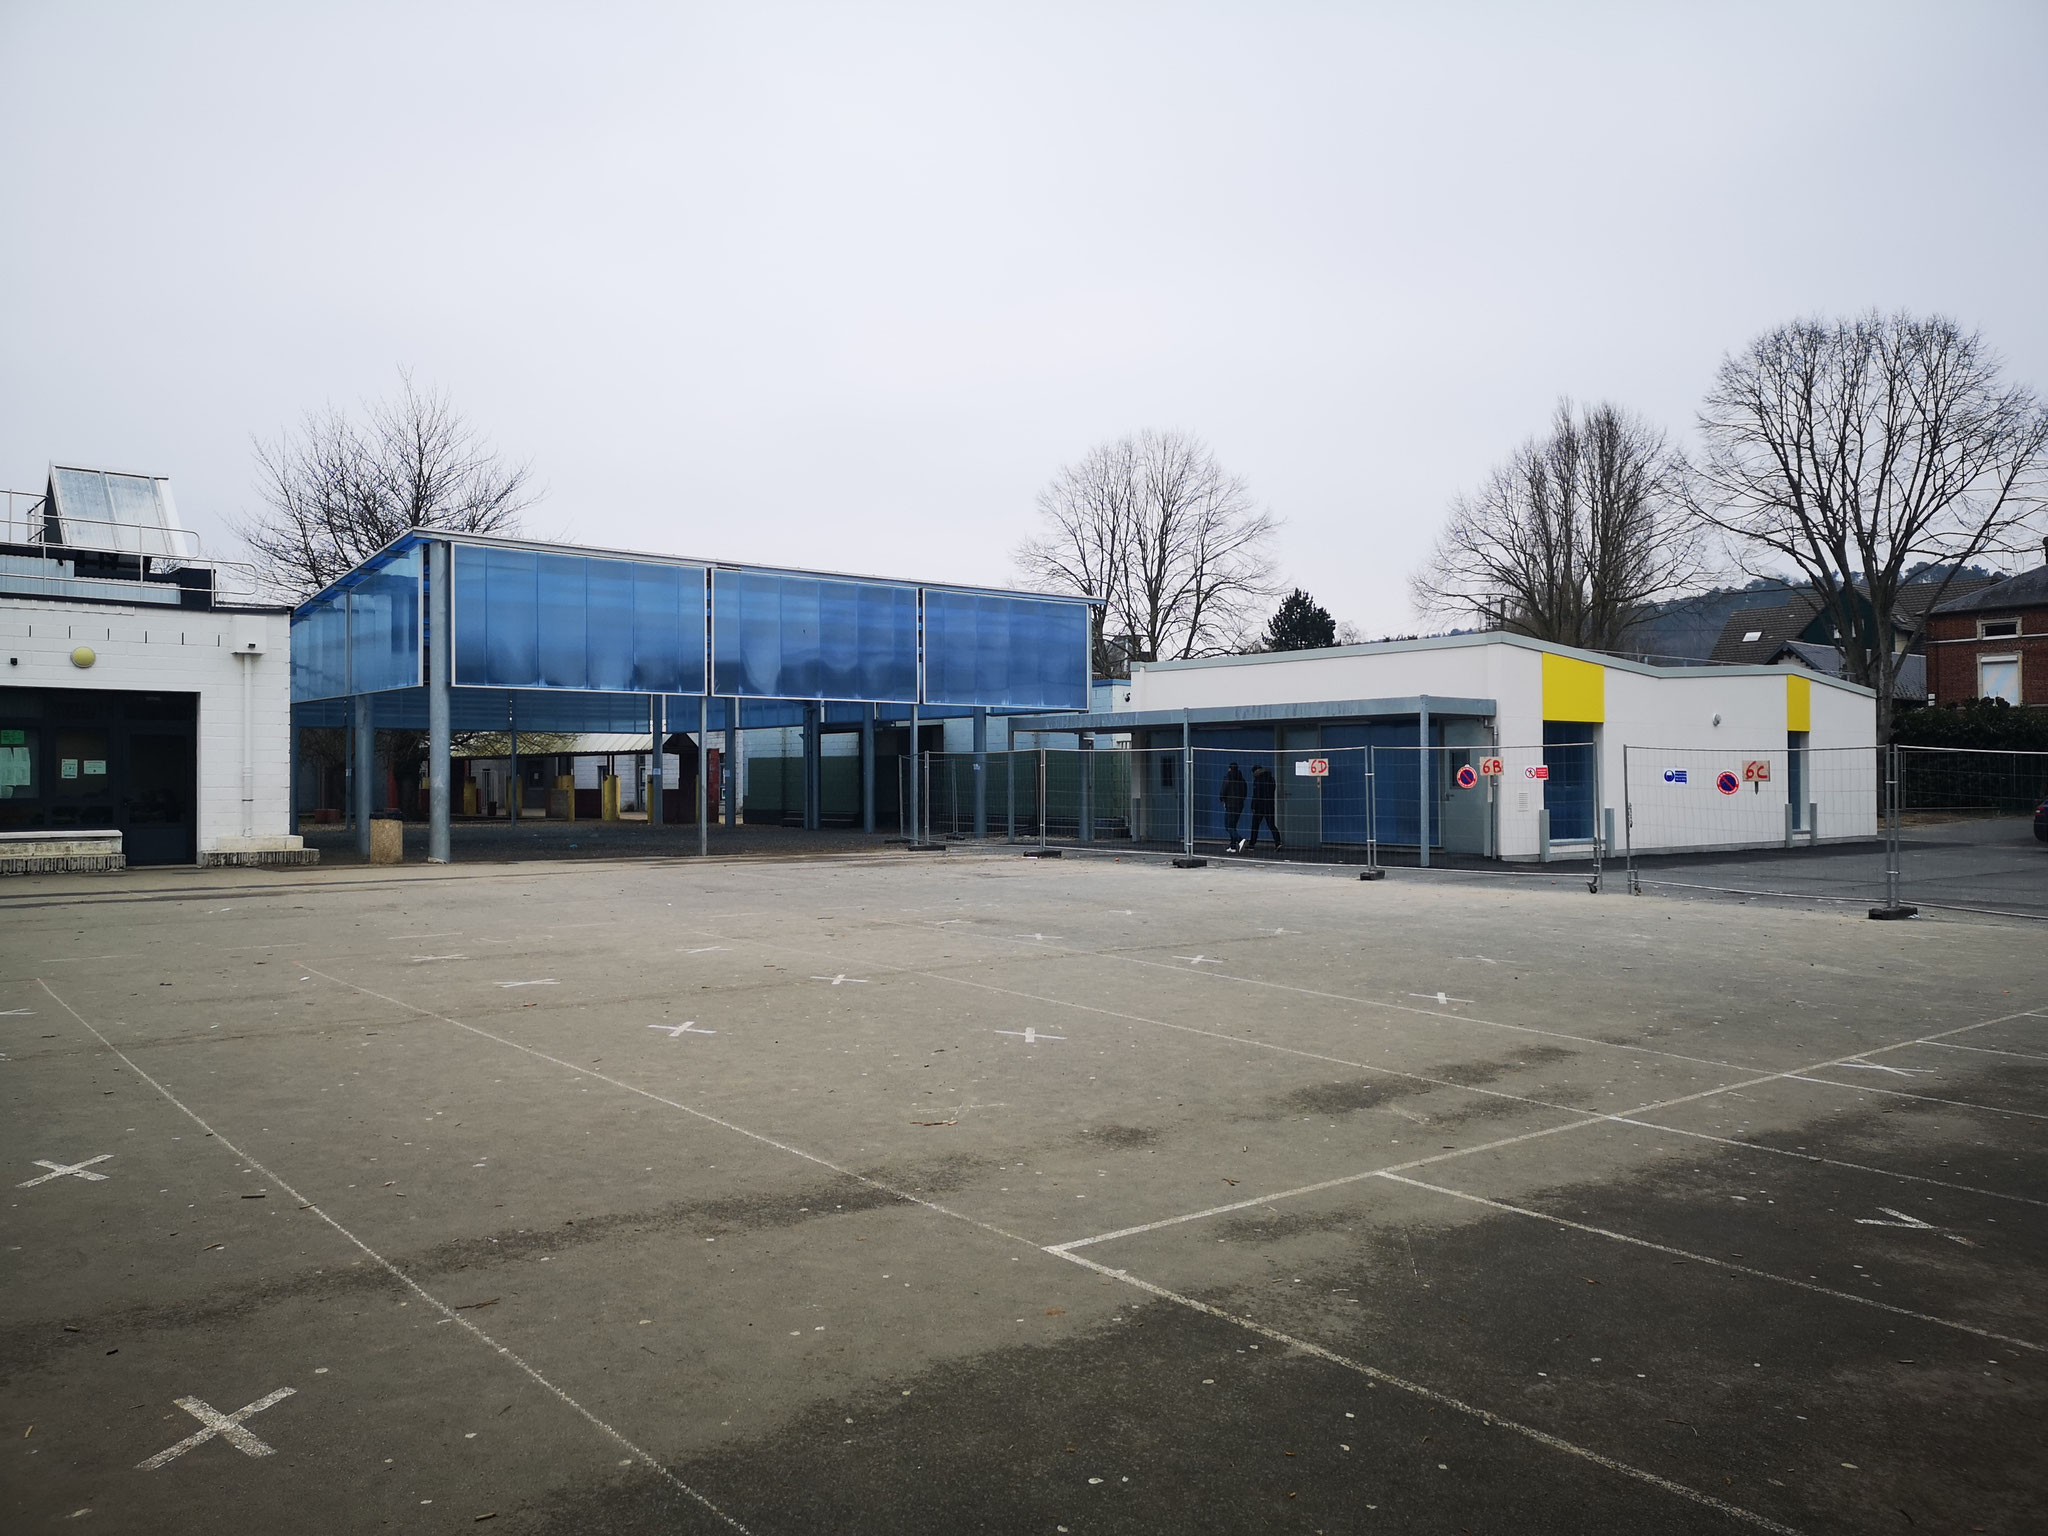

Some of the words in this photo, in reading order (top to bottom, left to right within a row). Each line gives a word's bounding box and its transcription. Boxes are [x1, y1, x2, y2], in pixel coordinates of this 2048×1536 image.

[1311, 760, 1327, 773] 6D
[1483, 759, 1502, 774] 6B
[1746, 761, 1768, 779] 6C
